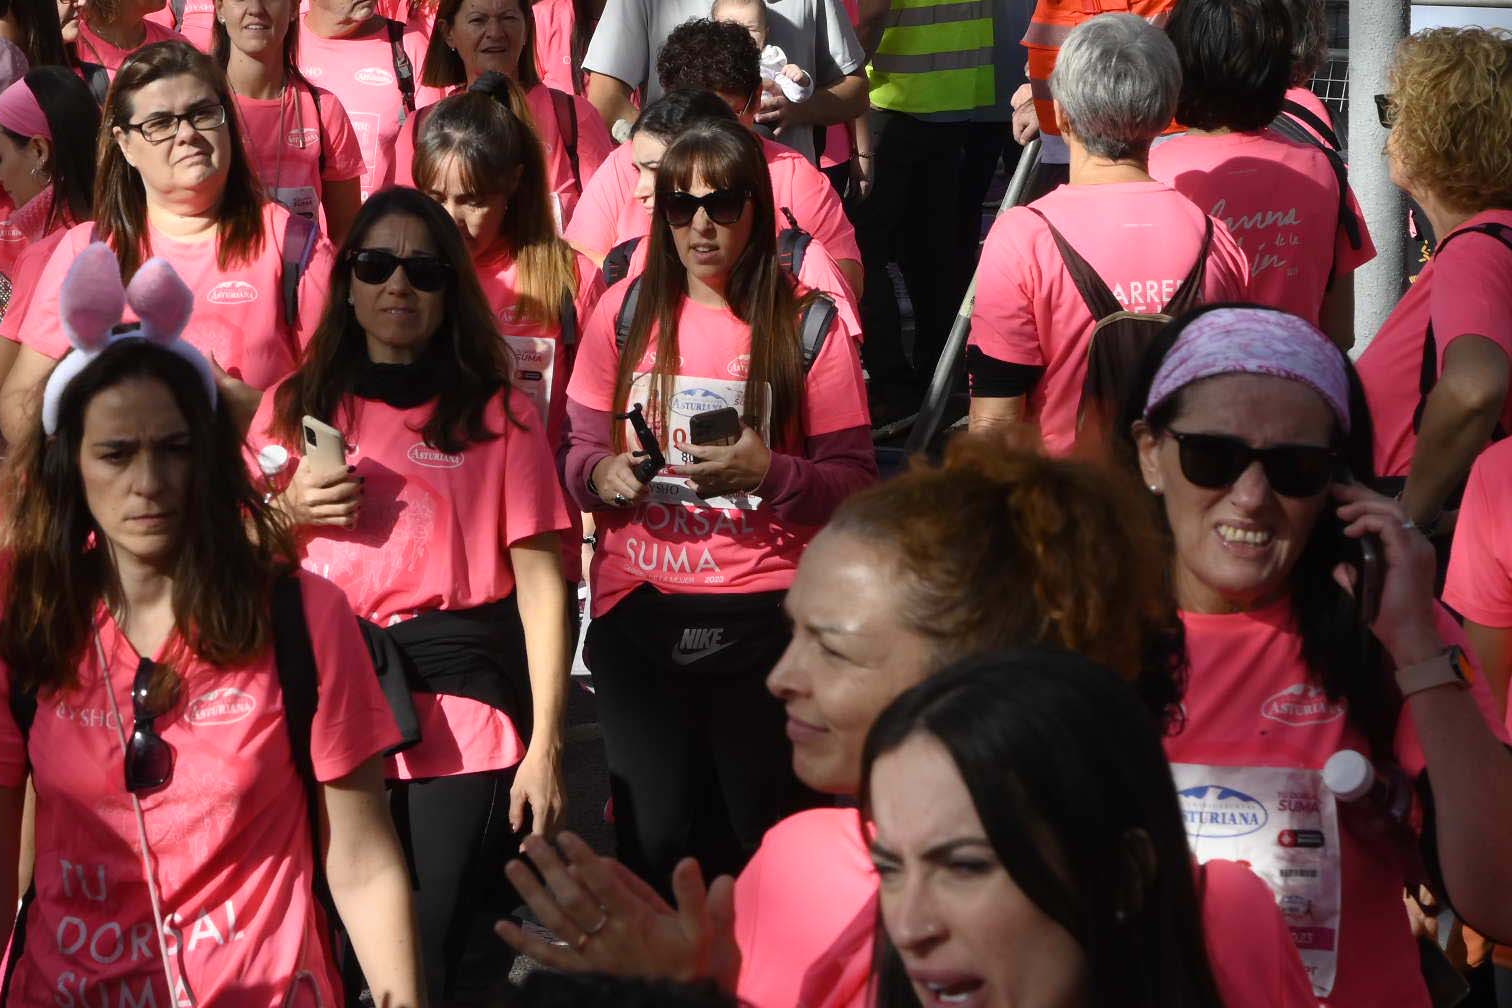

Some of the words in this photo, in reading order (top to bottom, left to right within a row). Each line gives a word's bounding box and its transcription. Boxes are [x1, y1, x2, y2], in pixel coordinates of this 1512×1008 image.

[412, 447, 460, 465] ASTURIANA
[626, 537, 721, 574] SUMA
[679, 627, 725, 650] NIKE
[59, 857, 108, 903] TU
[55, 899, 246, 964] DORSAL
